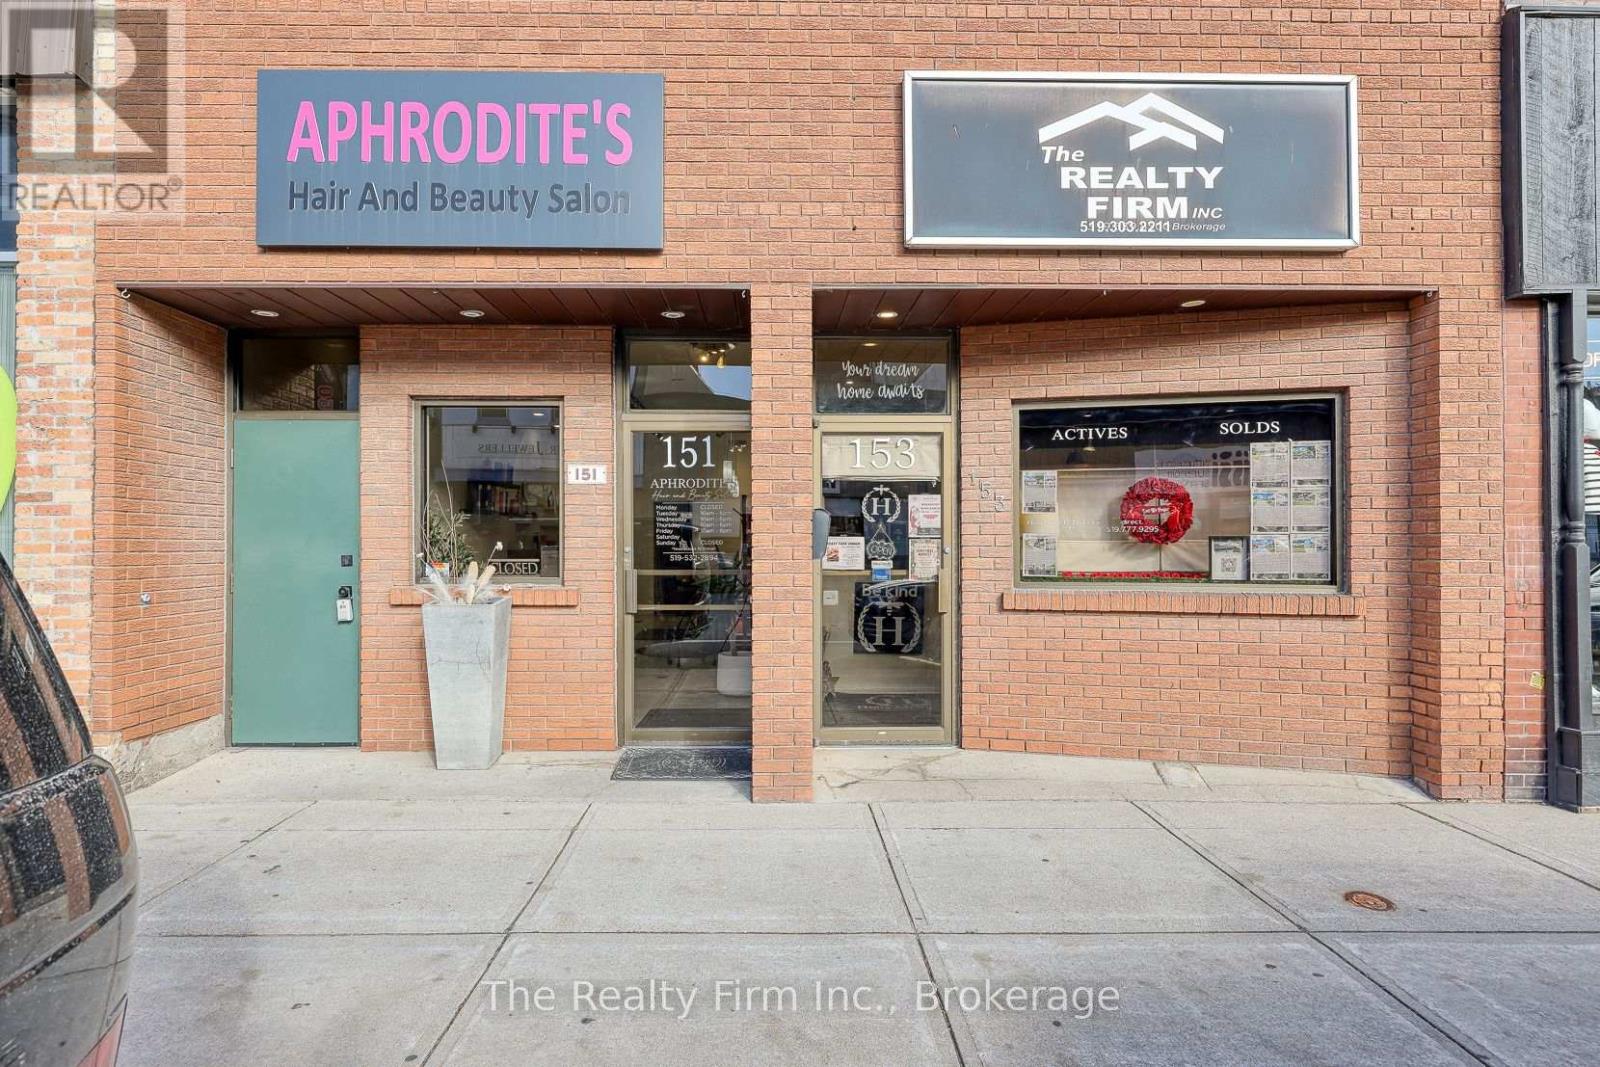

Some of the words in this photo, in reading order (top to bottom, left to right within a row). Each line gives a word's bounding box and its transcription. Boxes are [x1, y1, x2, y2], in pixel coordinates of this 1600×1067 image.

[286, 99, 634, 165] APHRODITE'S
[1041, 145, 1085, 164] The
[1059, 165, 1225, 190] REALTY
[288, 180, 347, 213] Hair
[358, 180, 418, 213] And
[429, 181, 538, 220] Beauty
[548, 182, 631, 216] Salon
[1087, 196, 1189, 219] FIRM
[1192, 207, 1223, 219] INC
[1079, 220, 1171, 233] 519.303.2211
[1171, 222, 1226, 233] Brokerage
[842, 360, 872, 377] Your
[875, 360, 920, 377] dream
[837, 382, 875, 399] home
[878, 382, 925, 399] awaits
[1051, 426, 1129, 441] ACTIVES
[1219, 419, 1281, 435] SOLDS
[661, 435, 716, 468] 151
[848, 437, 917, 469] 153
[574, 467, 598, 481] 151
[491, 562, 538, 576] CLOSED
